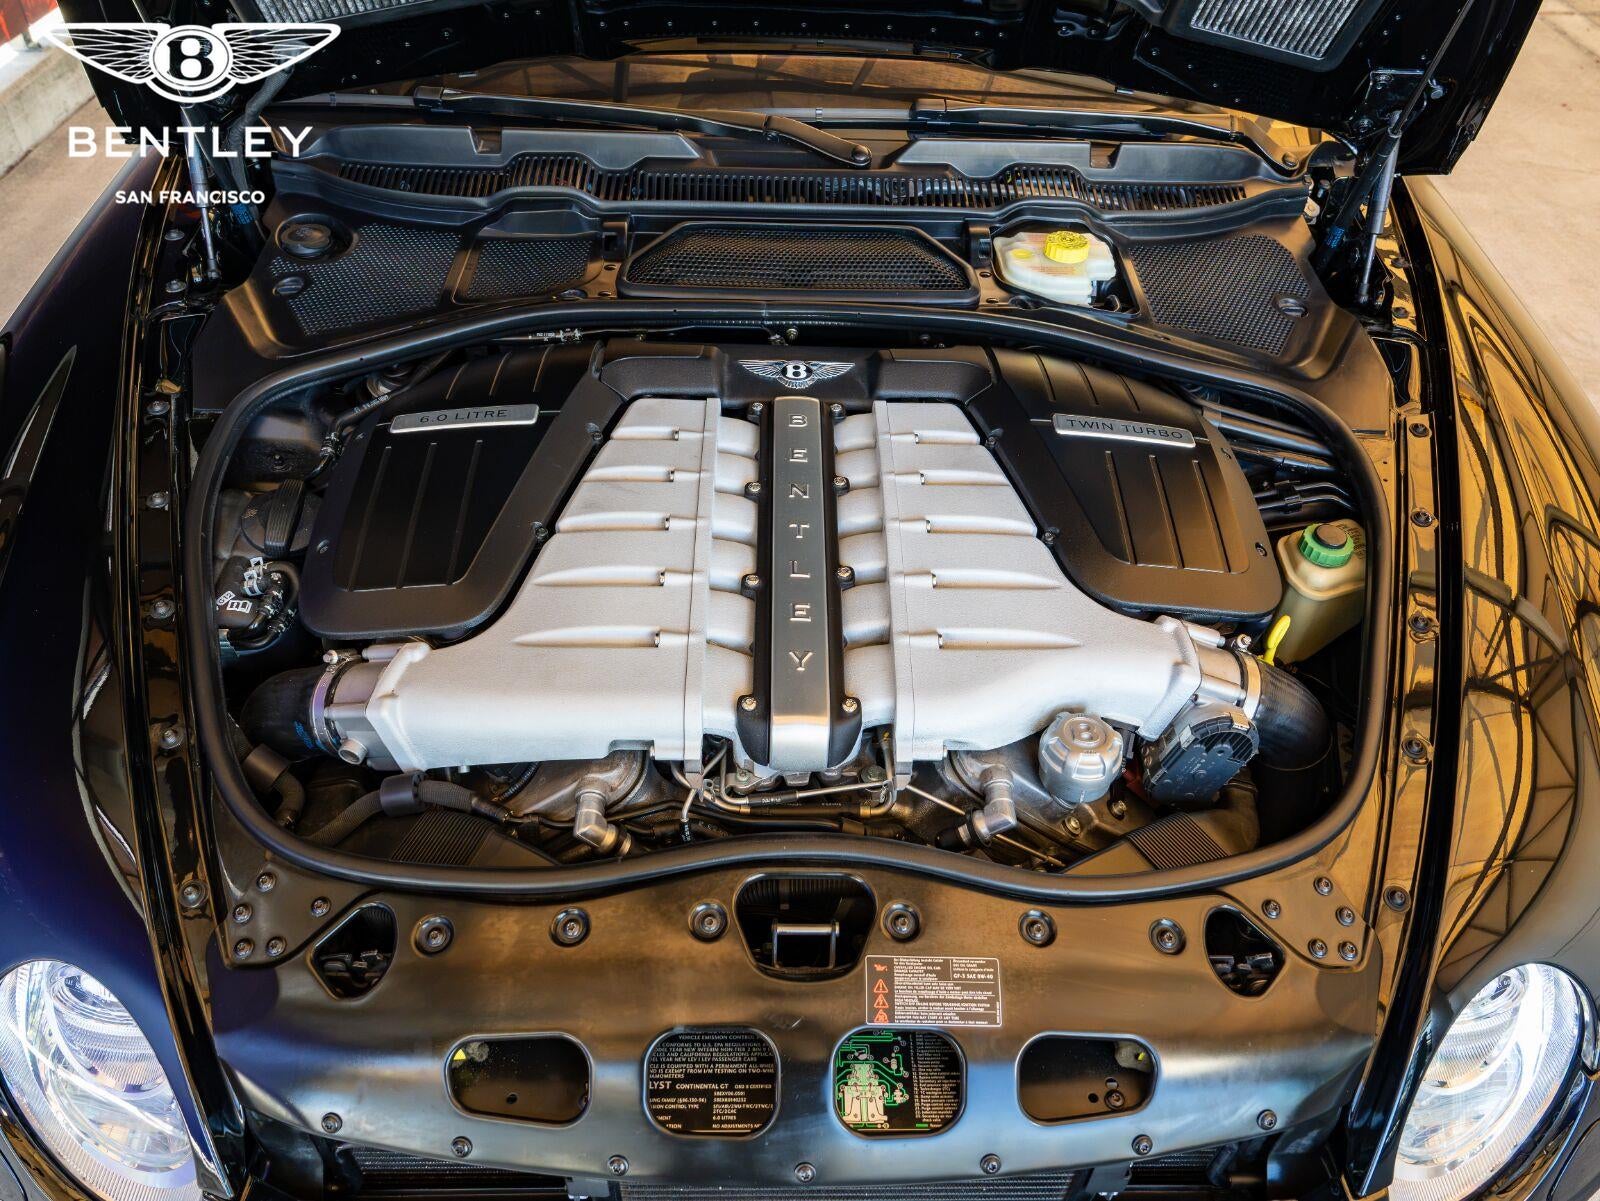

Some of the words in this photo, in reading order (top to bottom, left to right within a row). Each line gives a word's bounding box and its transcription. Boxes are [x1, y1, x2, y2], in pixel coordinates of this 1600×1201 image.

[419, 414, 448, 424] 6.0
[455, 409, 508, 420] LITRE
[1066, 418, 1114, 431] TWIN
[1122, 424, 1183, 439] TURBO
[788, 413, 814, 672] BENTLEY
